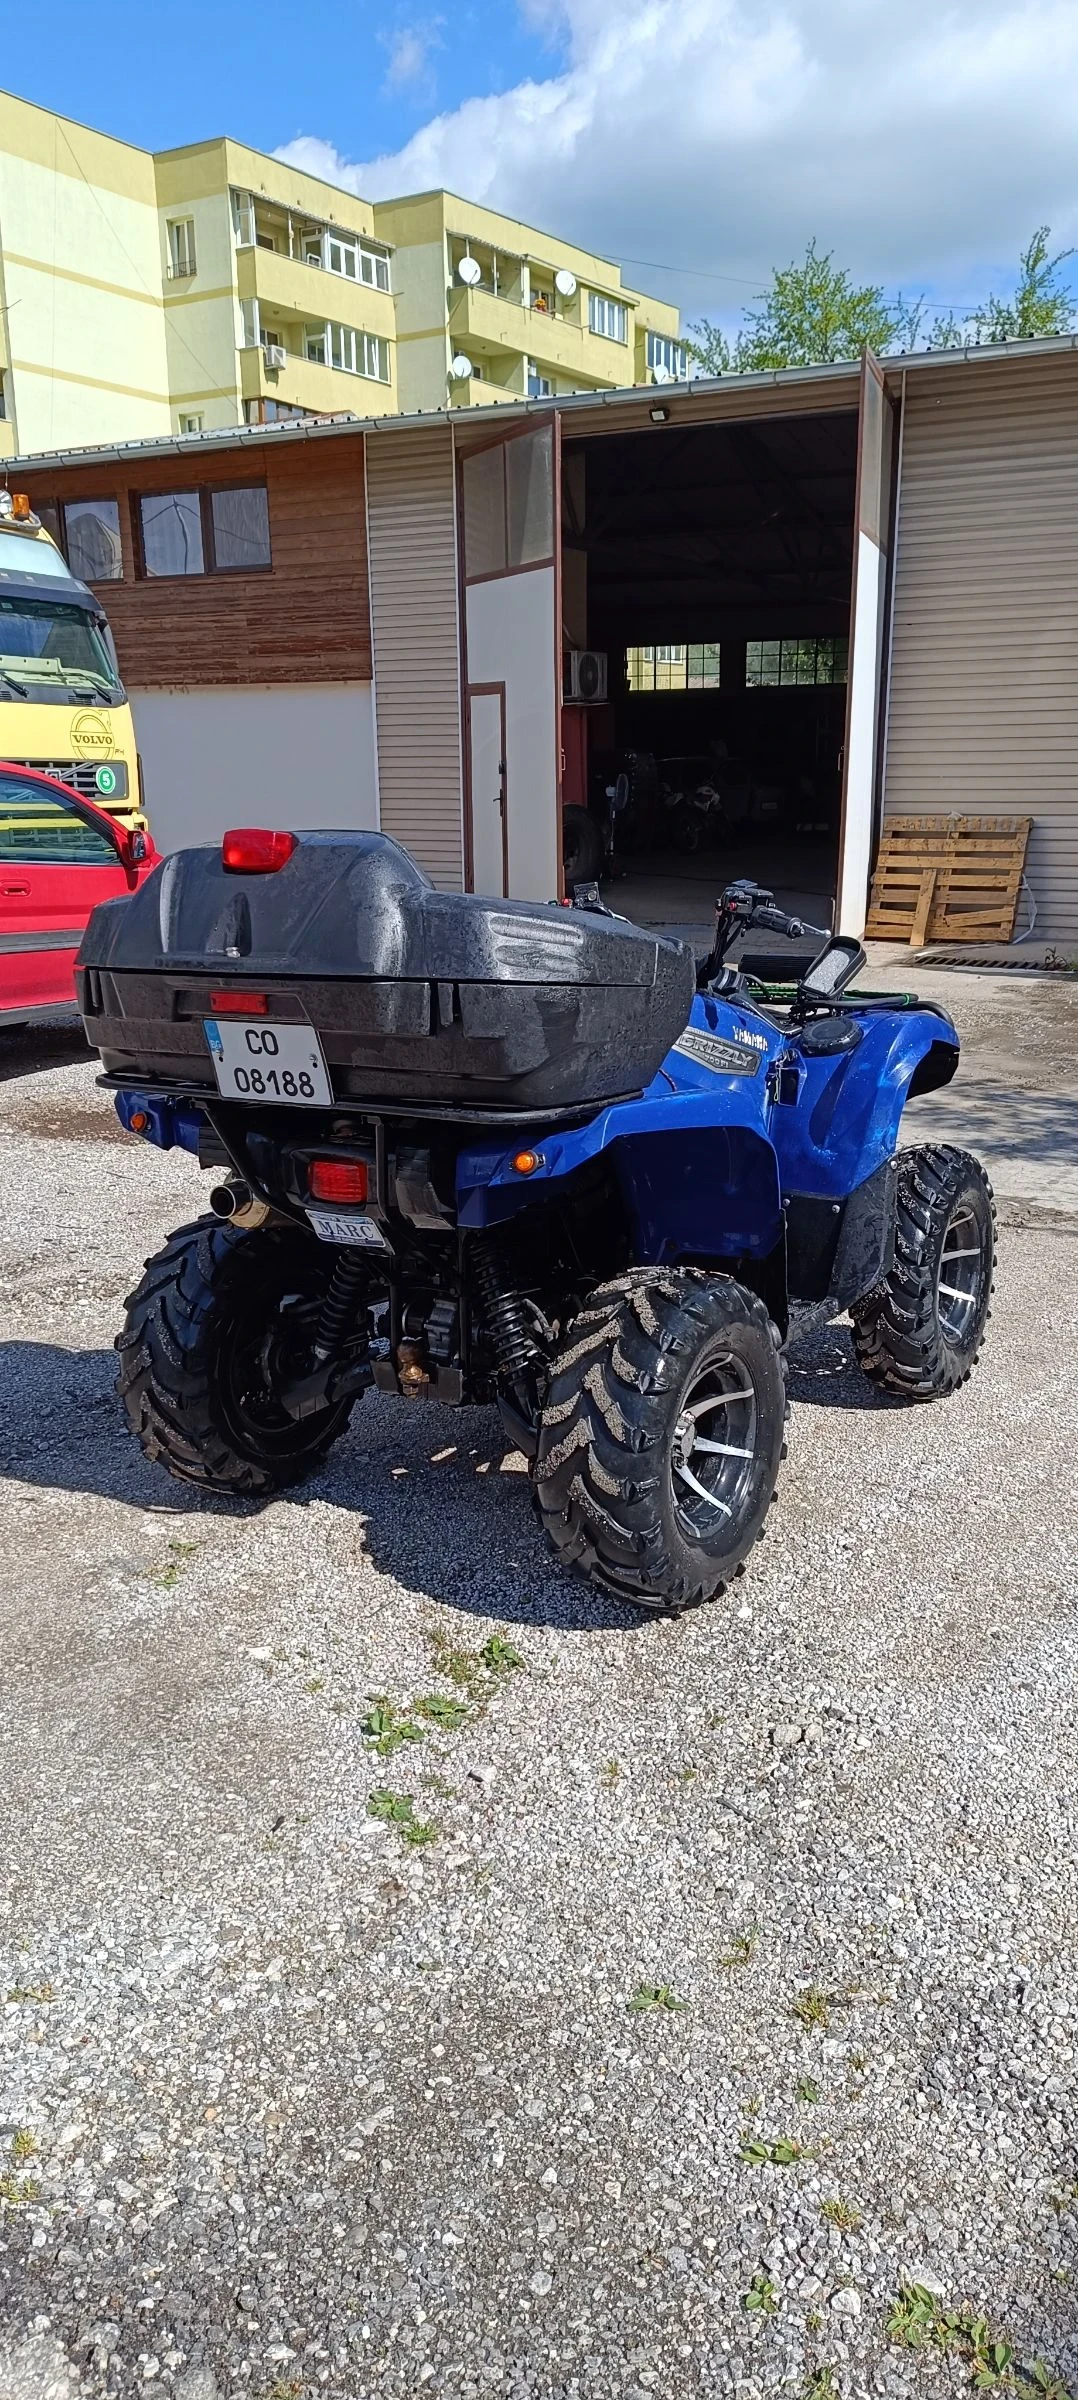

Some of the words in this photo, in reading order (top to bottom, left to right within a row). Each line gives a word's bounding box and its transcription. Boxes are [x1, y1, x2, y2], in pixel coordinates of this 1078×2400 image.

[72, 735, 113, 744] VOLVO
[102, 774, 111, 785] 5
[245, 1029, 279, 1055] CO
[680, 1033, 753, 1067] GRIZZLY
[233, 1067, 315, 1098] 08188
[318, 1220, 374, 1239] MARC
